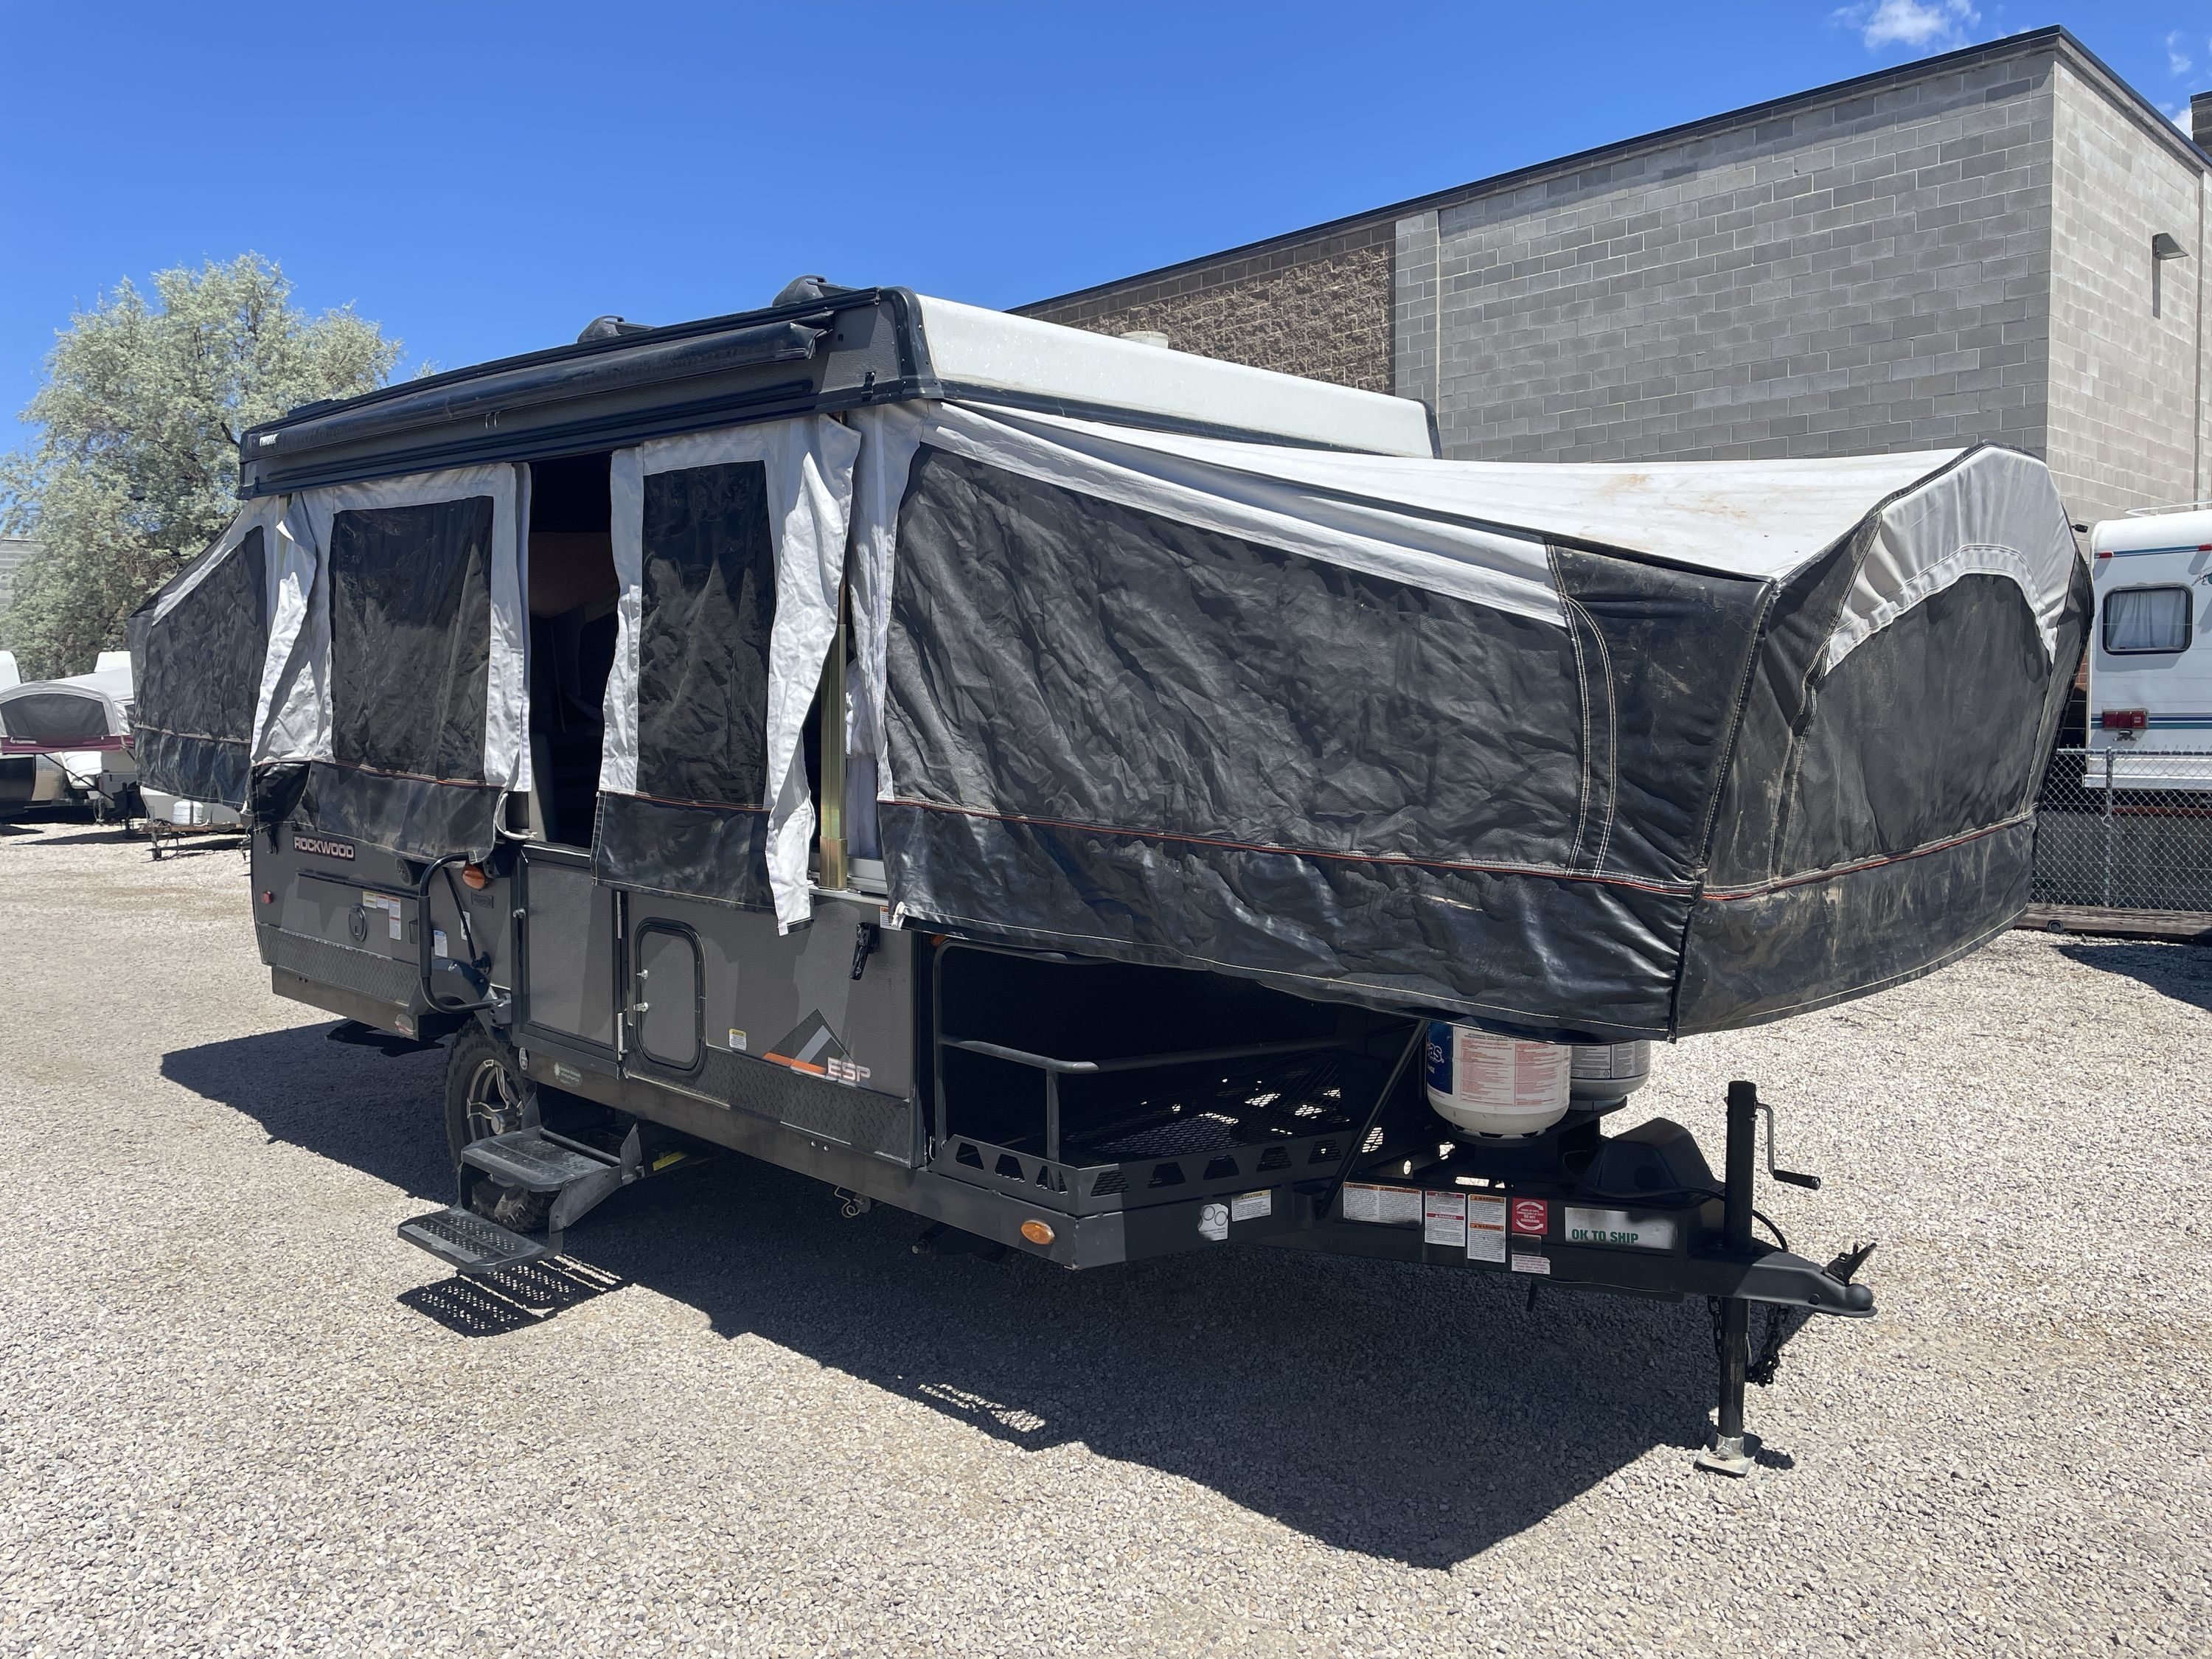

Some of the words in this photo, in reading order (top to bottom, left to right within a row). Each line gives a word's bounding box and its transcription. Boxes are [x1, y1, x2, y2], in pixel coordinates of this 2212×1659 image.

[294, 836, 354, 858] ROCKWOOD
[827, 1057, 872, 1082] ESP
[1571, 1229, 1588, 1241] OK
[1591, 1230, 1607, 1242] TO
[1610, 1231, 1639, 1244] SHIP
